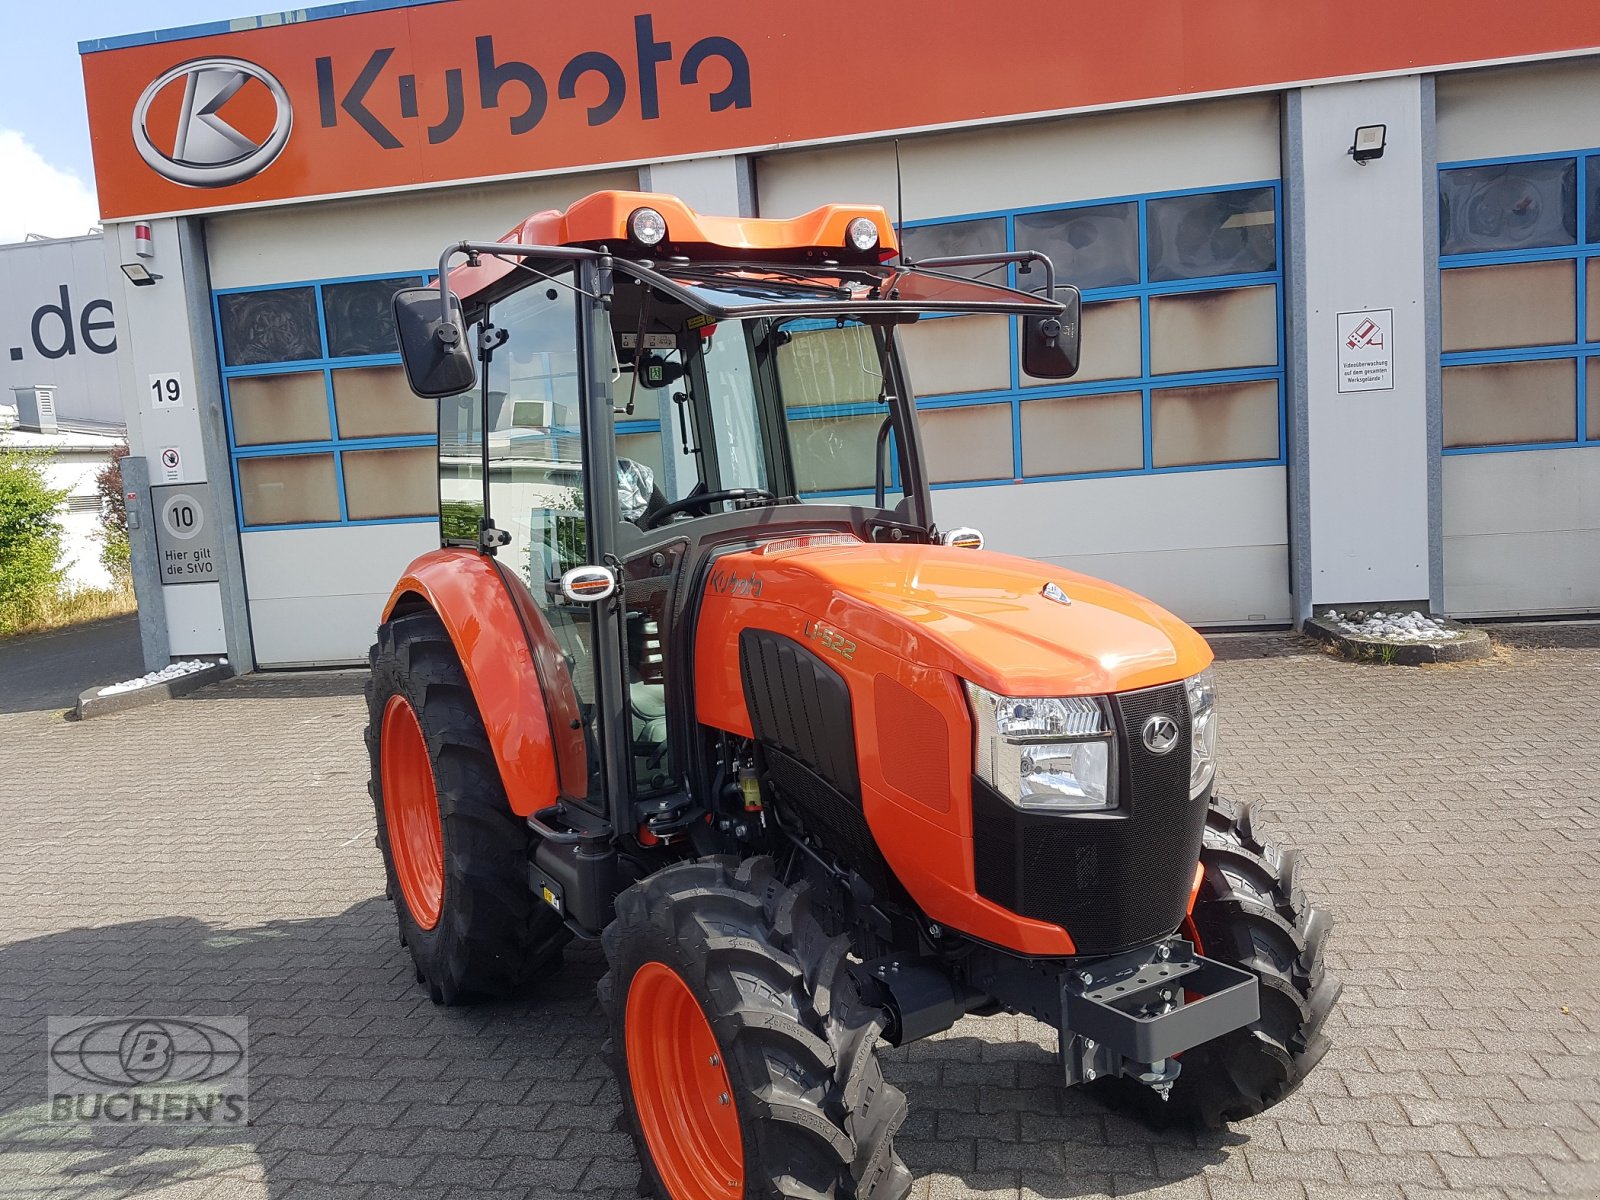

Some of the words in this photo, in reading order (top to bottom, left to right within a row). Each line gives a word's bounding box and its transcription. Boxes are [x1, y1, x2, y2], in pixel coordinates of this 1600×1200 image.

[314, 13, 753, 150] Kubota
[10, 284, 118, 360] .de
[152, 378, 181, 402] 19
[172, 506, 193, 528] 10
[165, 550, 188, 560] Hier
[193, 548, 211, 561] gilt
[167, 564, 183, 575] die
[187, 562, 213, 574] StVO
[710, 569, 763, 598] Kubota
